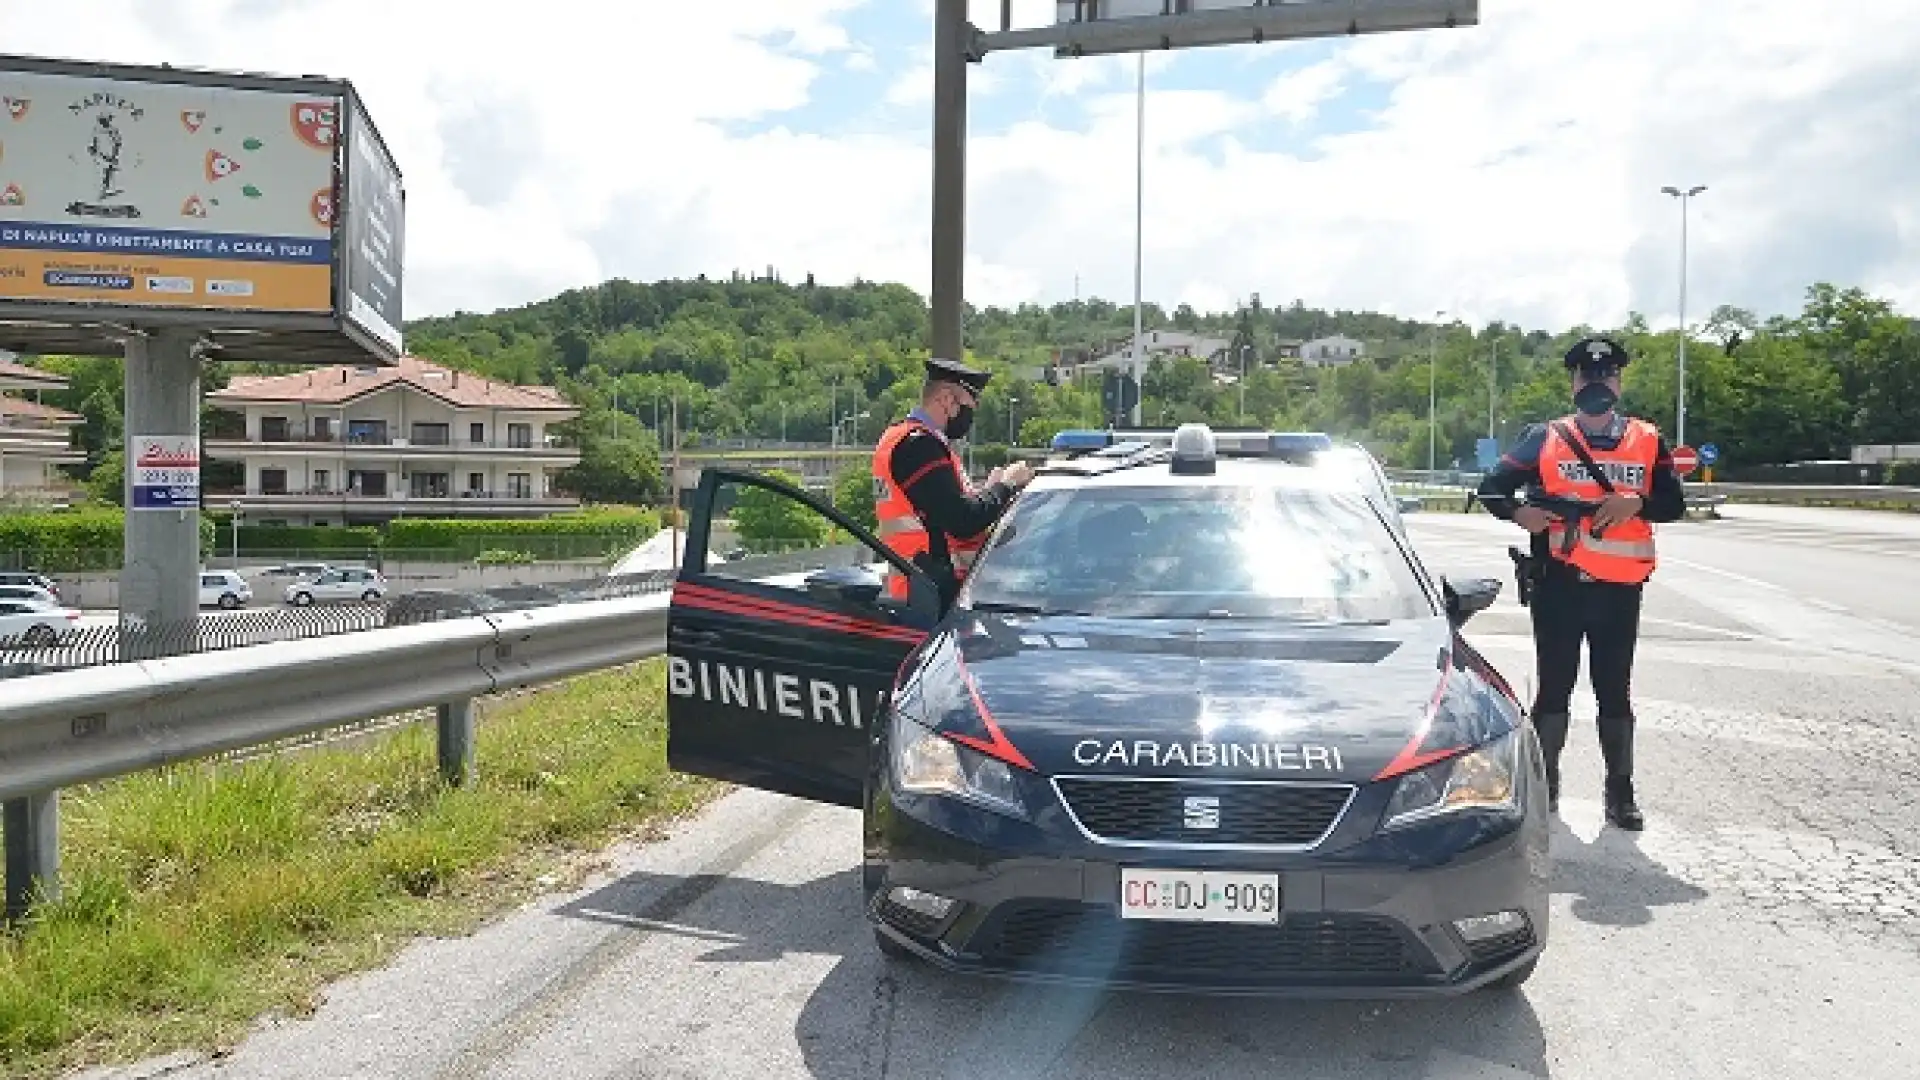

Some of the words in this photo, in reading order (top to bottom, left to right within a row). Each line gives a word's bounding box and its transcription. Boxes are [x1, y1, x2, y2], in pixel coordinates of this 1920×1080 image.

[1073, 738, 1344, 772] CARABINIERI
[1125, 880, 1157, 908] CC
[1175, 880, 1207, 910] DJ
[1225, 883, 1276, 913] 909
